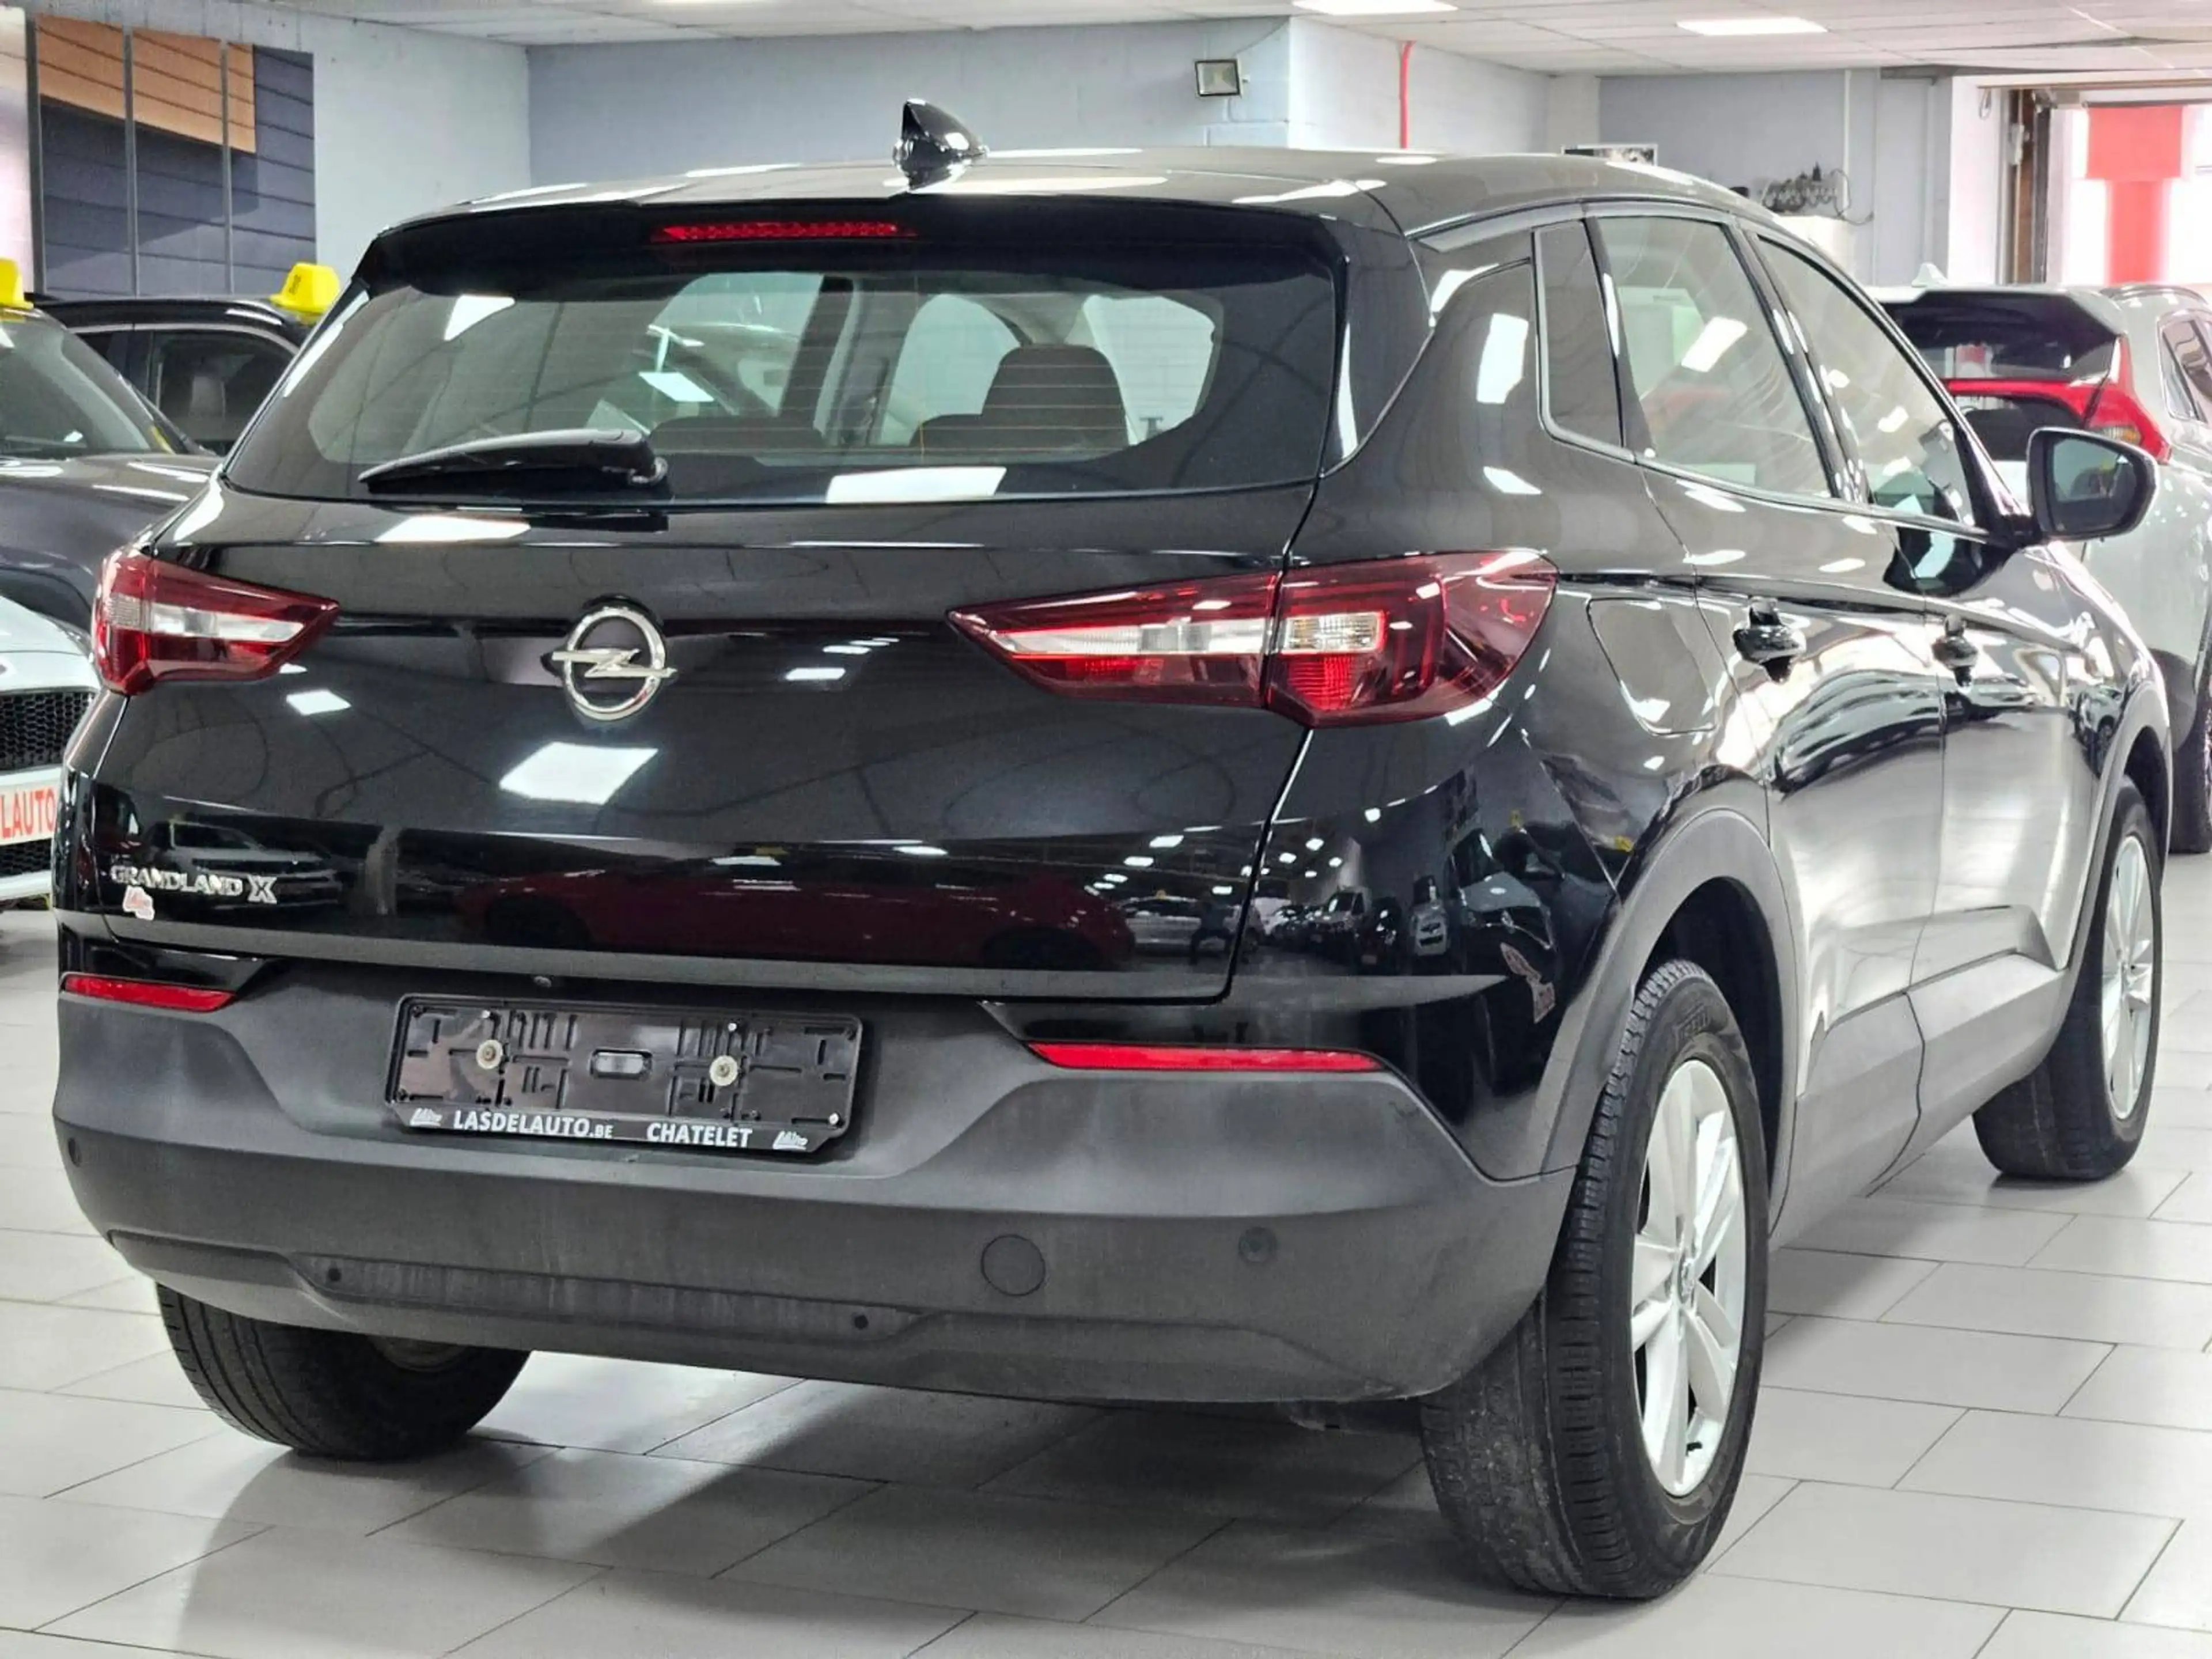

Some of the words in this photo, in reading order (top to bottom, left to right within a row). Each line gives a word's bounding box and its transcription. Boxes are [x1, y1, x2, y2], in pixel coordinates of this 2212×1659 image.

[110, 865, 243, 896] GRANDLAND
[247, 874, 277, 904] X
[453, 1109, 613, 1139] LASDELAUTO.BE
[646, 1122, 753, 1148] CHATELET
